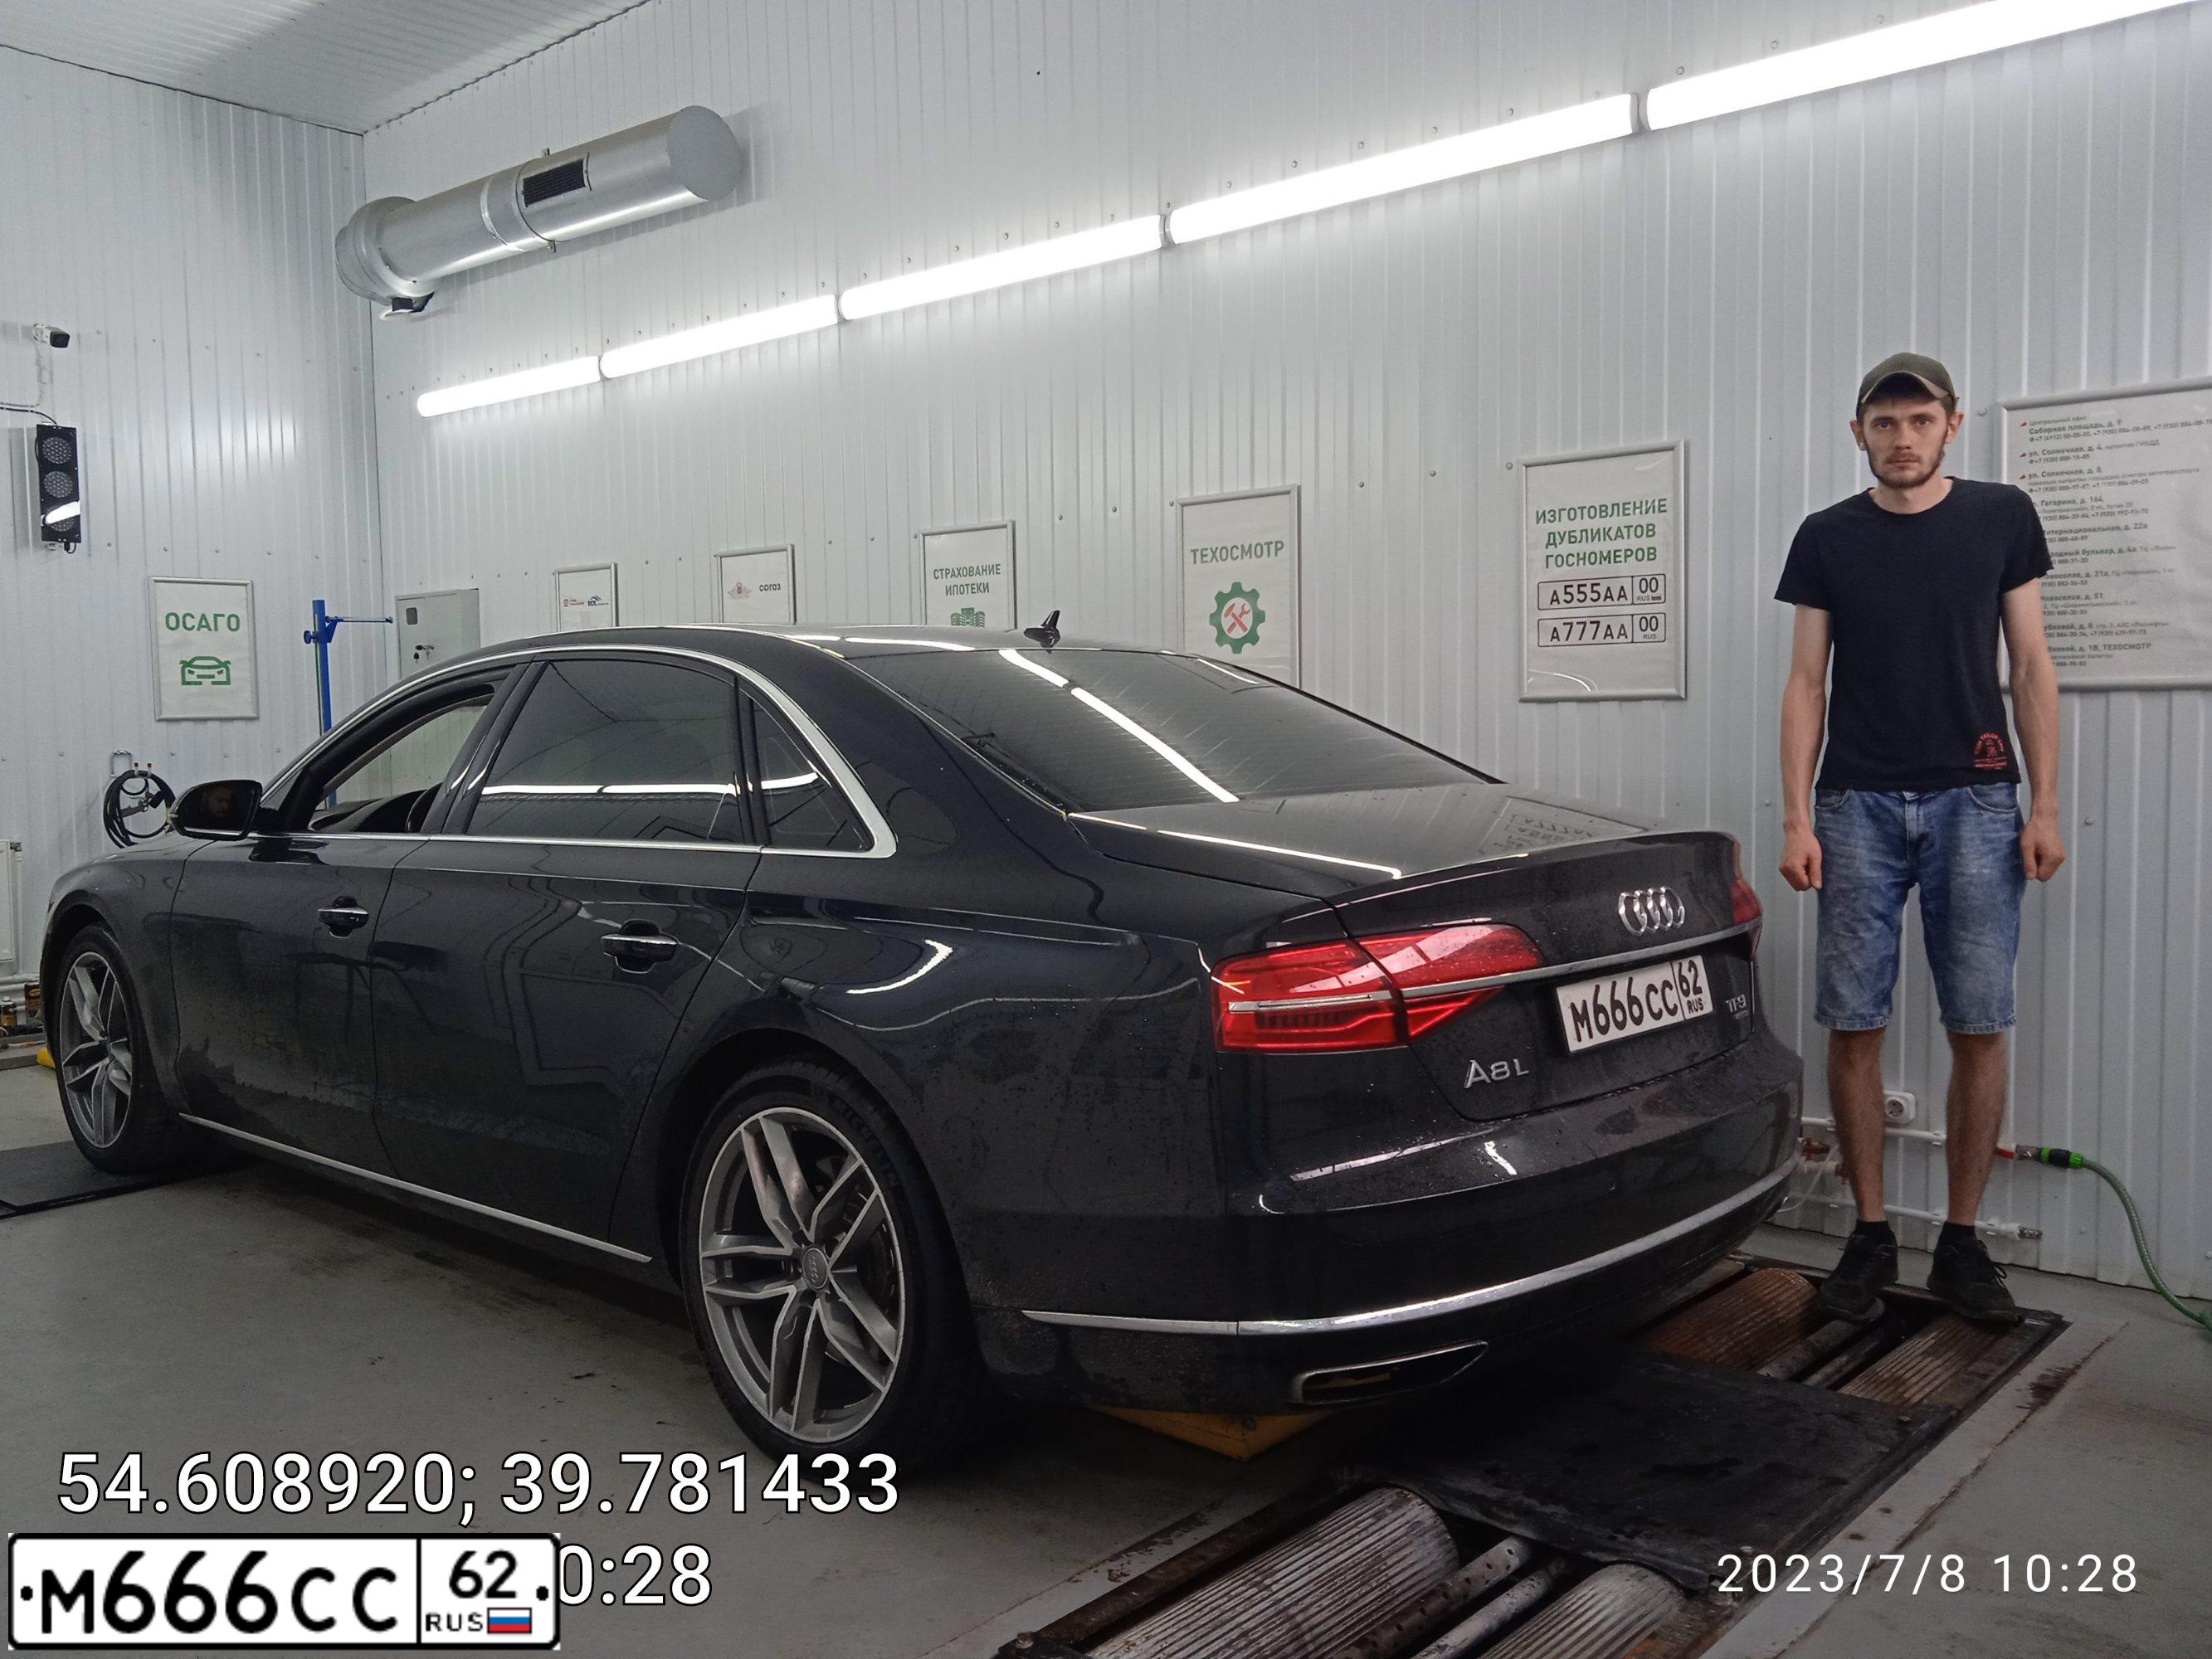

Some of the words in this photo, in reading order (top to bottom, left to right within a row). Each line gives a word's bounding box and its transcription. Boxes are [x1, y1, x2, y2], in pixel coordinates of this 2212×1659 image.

[2029, 426, 2066, 435] Соборная
[2041, 446, 2085, 455] Солнечная,
[2041, 469, 2085, 478] Солнечная,
[1536, 498, 1668, 524] ИЗГОТОВЛЕНИЕ
[1545, 523, 1656, 549] ДУБЛИКАТОВ
[1191, 540, 1284, 565] ТЕХОСМОТР
[1545, 547, 1658, 569] ГОСНОМЕРОВ
[933, 563, 1001, 580] СТРАХОВАНИЕ
[946, 582, 990, 596] ИПОТЕКИ
[1550, 582, 1628, 606] А555АА
[165, 612, 241, 632] ОСАГО
[1550, 620, 1628, 643] А777АА
[2044, 623, 2077, 631] убковой,
[2102, 643, 2151, 651] ТЕХОСМОТР
[1570, 976, 1678, 1043] М666СС
[1678, 959, 1703, 996] 62
[1688, 997, 1704, 1014] RUS
[1464, 1058, 1530, 1089] A8L
